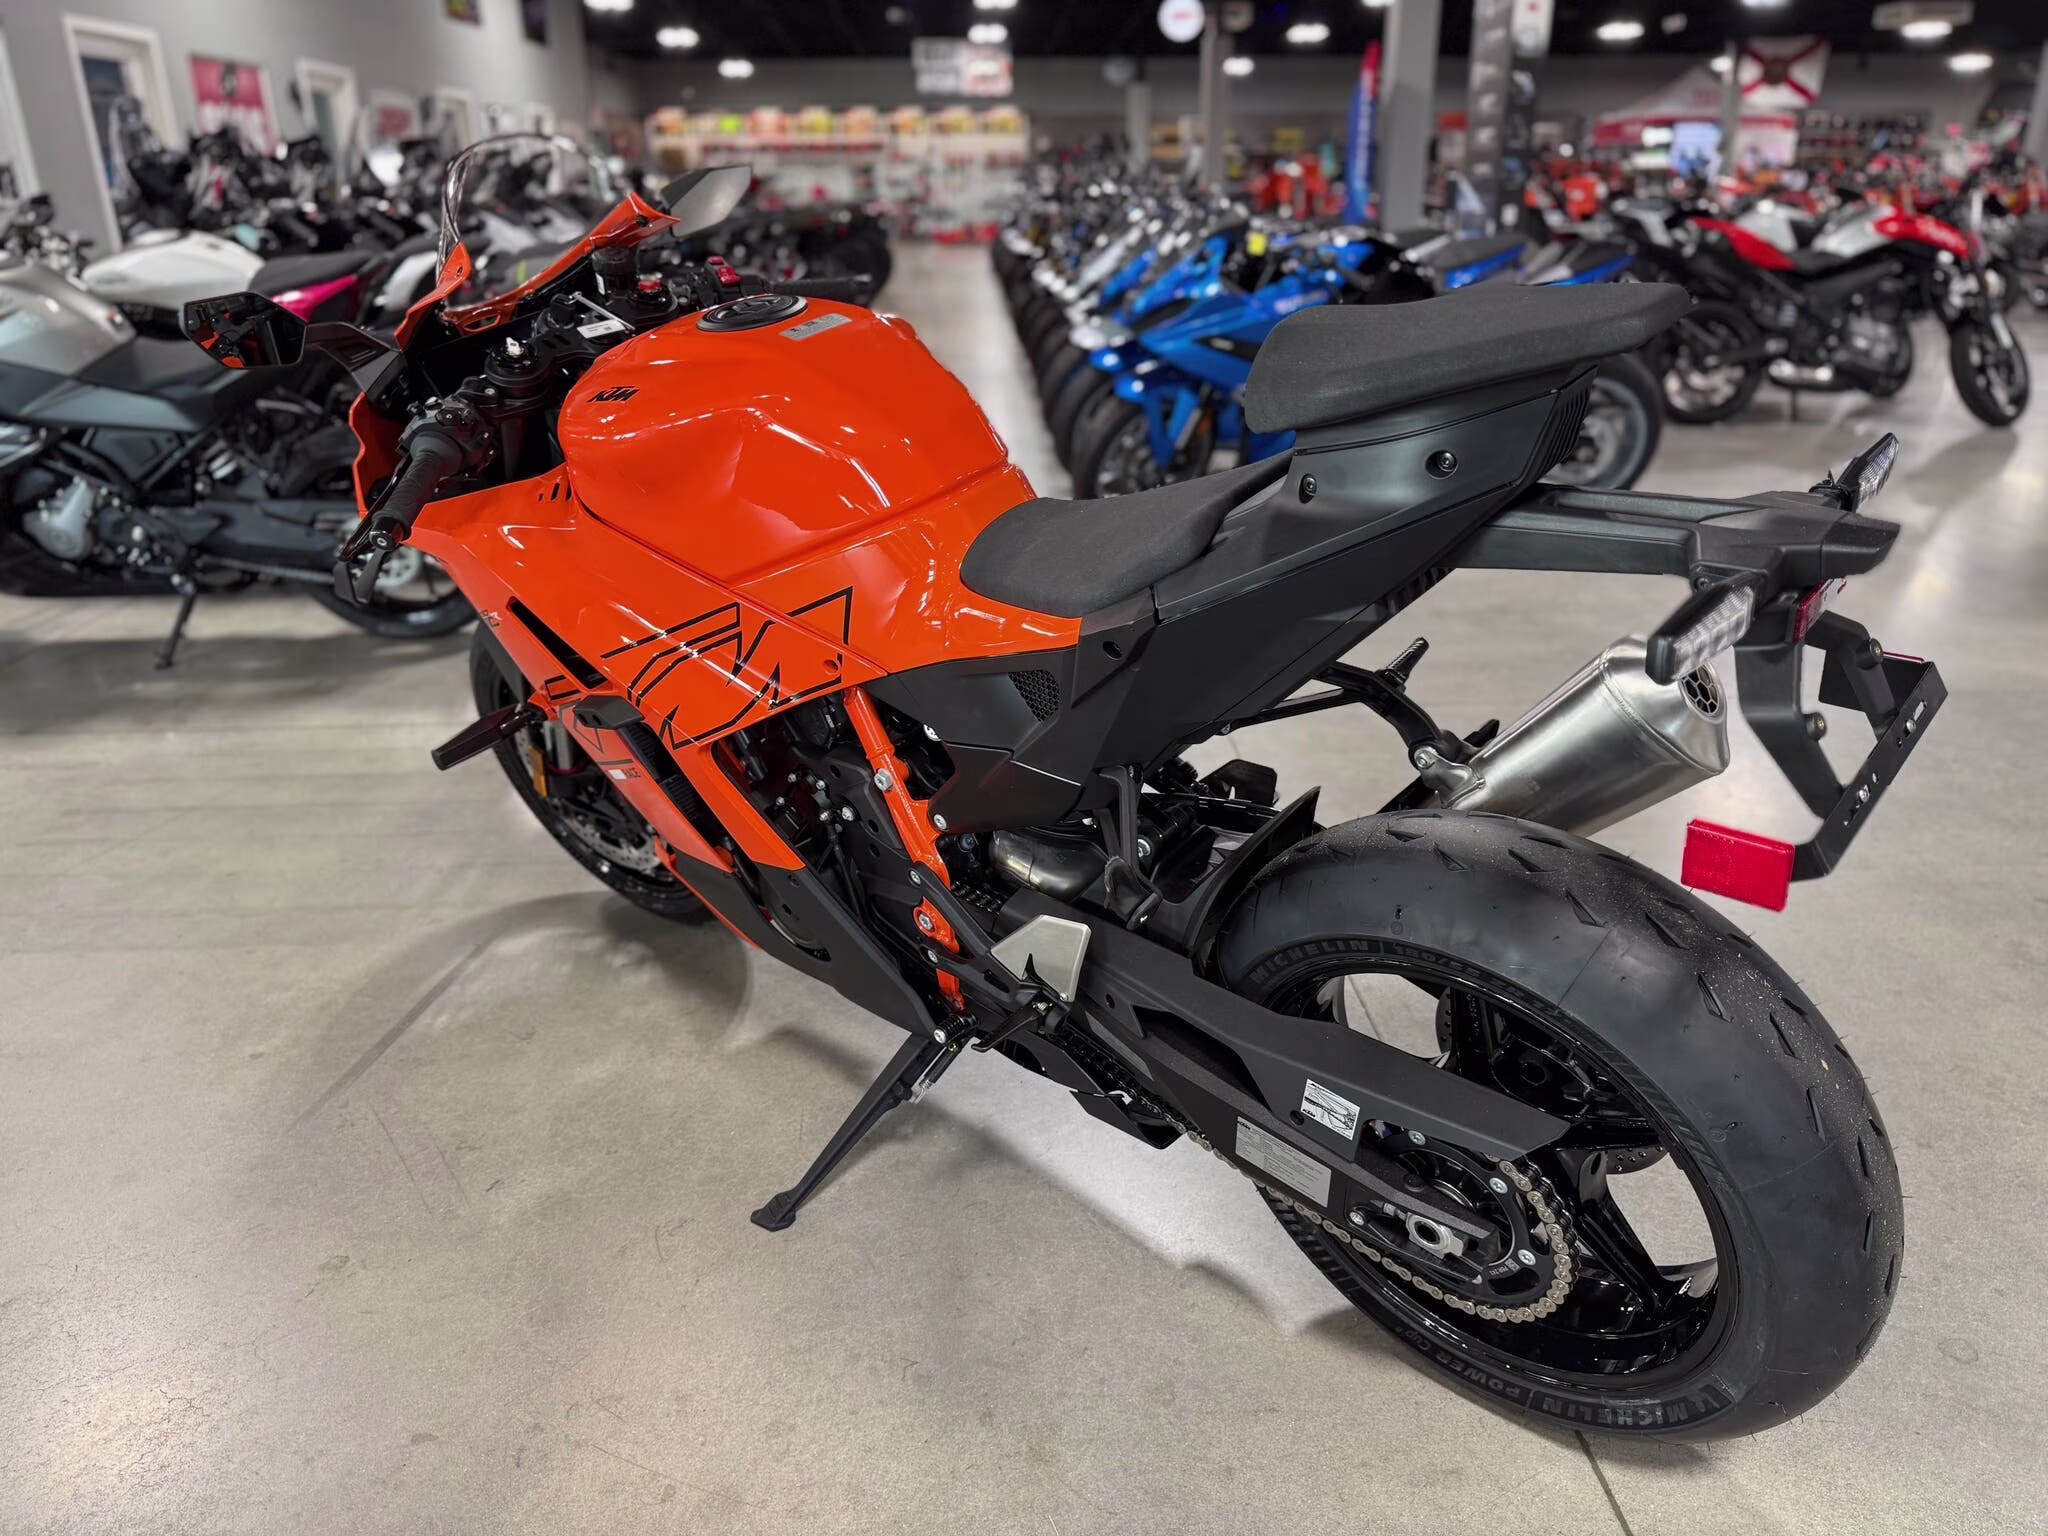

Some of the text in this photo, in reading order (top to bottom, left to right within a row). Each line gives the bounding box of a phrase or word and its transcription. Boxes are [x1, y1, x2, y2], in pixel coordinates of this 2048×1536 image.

[586, 386, 640, 402] KTM
[1250, 940, 1370, 985] MICHELIN
[1435, 1351, 1520, 1397] POWER
[1542, 1397, 1689, 1426] MICHELIN
